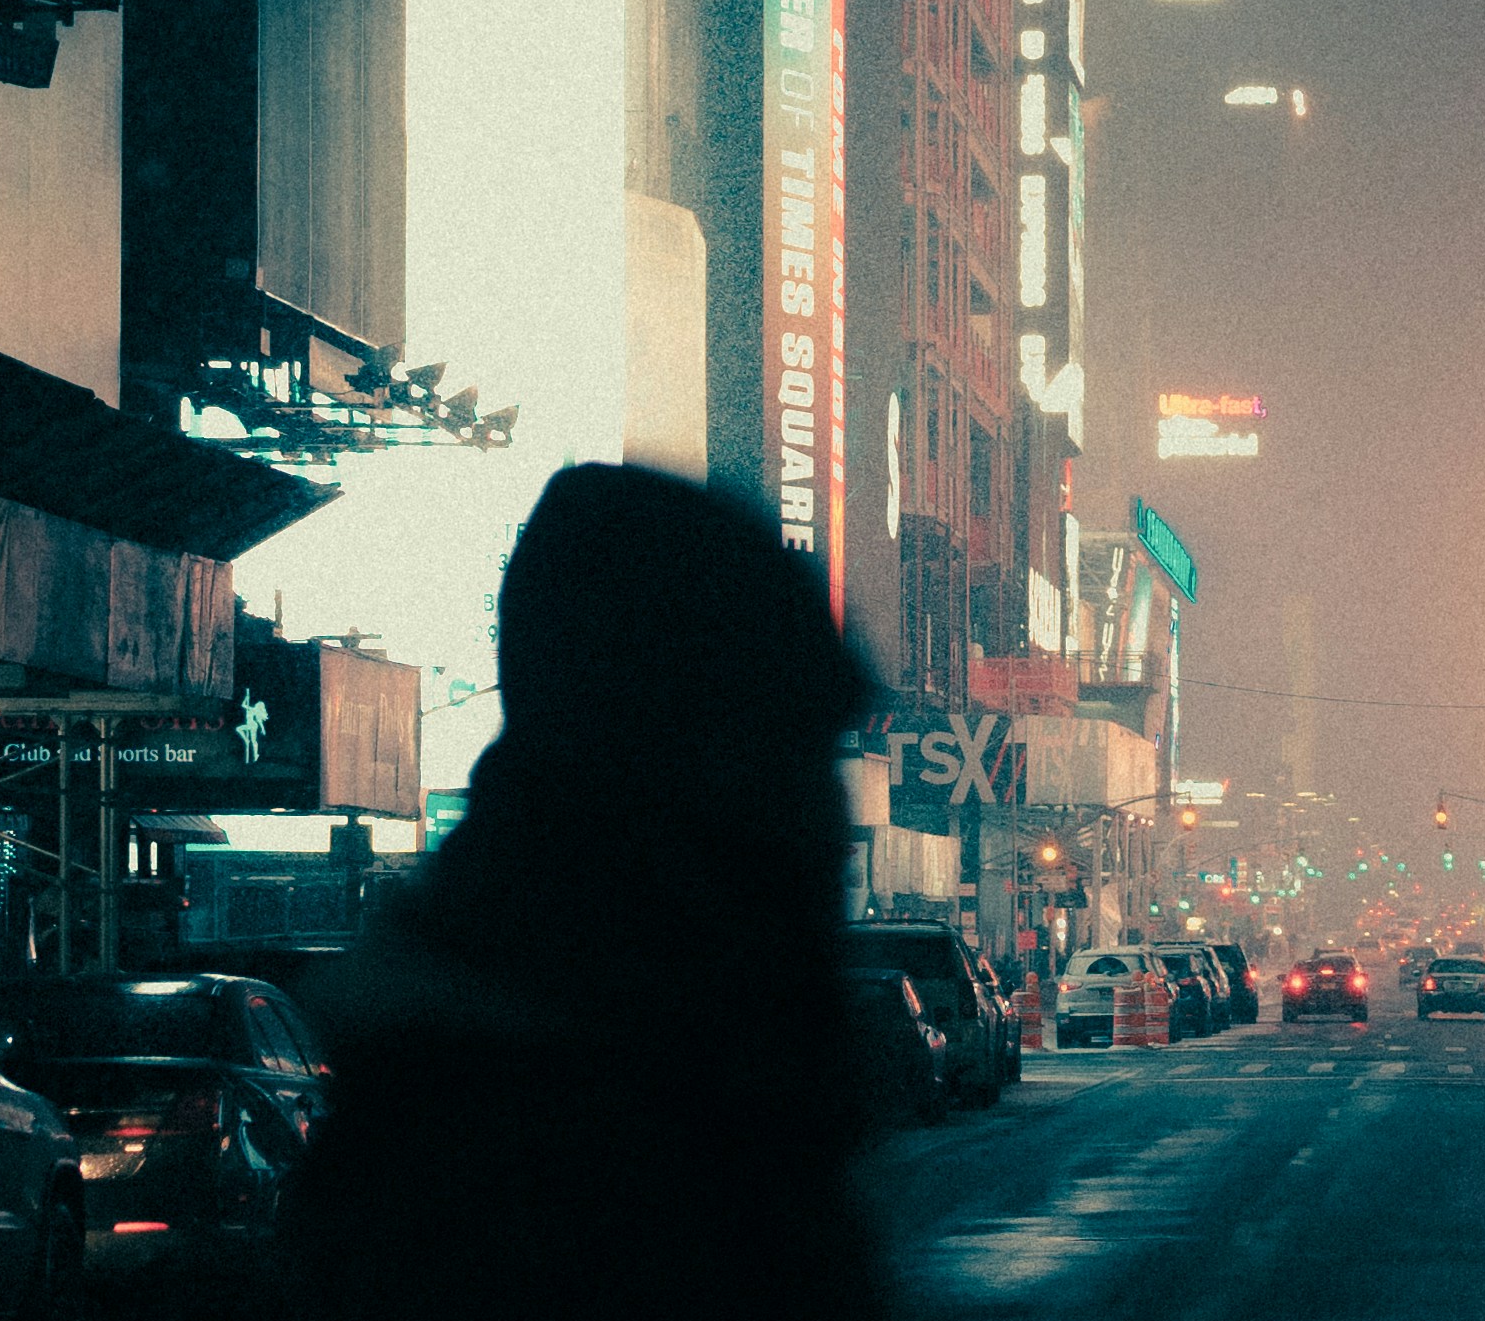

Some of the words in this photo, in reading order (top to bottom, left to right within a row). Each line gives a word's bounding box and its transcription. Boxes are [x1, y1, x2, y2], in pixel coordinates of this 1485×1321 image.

[780, 61, 814, 130] OF
[832, 28, 845, 220] COME
[780, 145, 815, 318] TIMES
[781, 331, 815, 553] SQUARE
[832, 240, 845, 483] INSIDE!
[3, 742, 52, 762] Club
[165, 743, 197, 763] bar
[885, 713, 1001, 806] TSX
